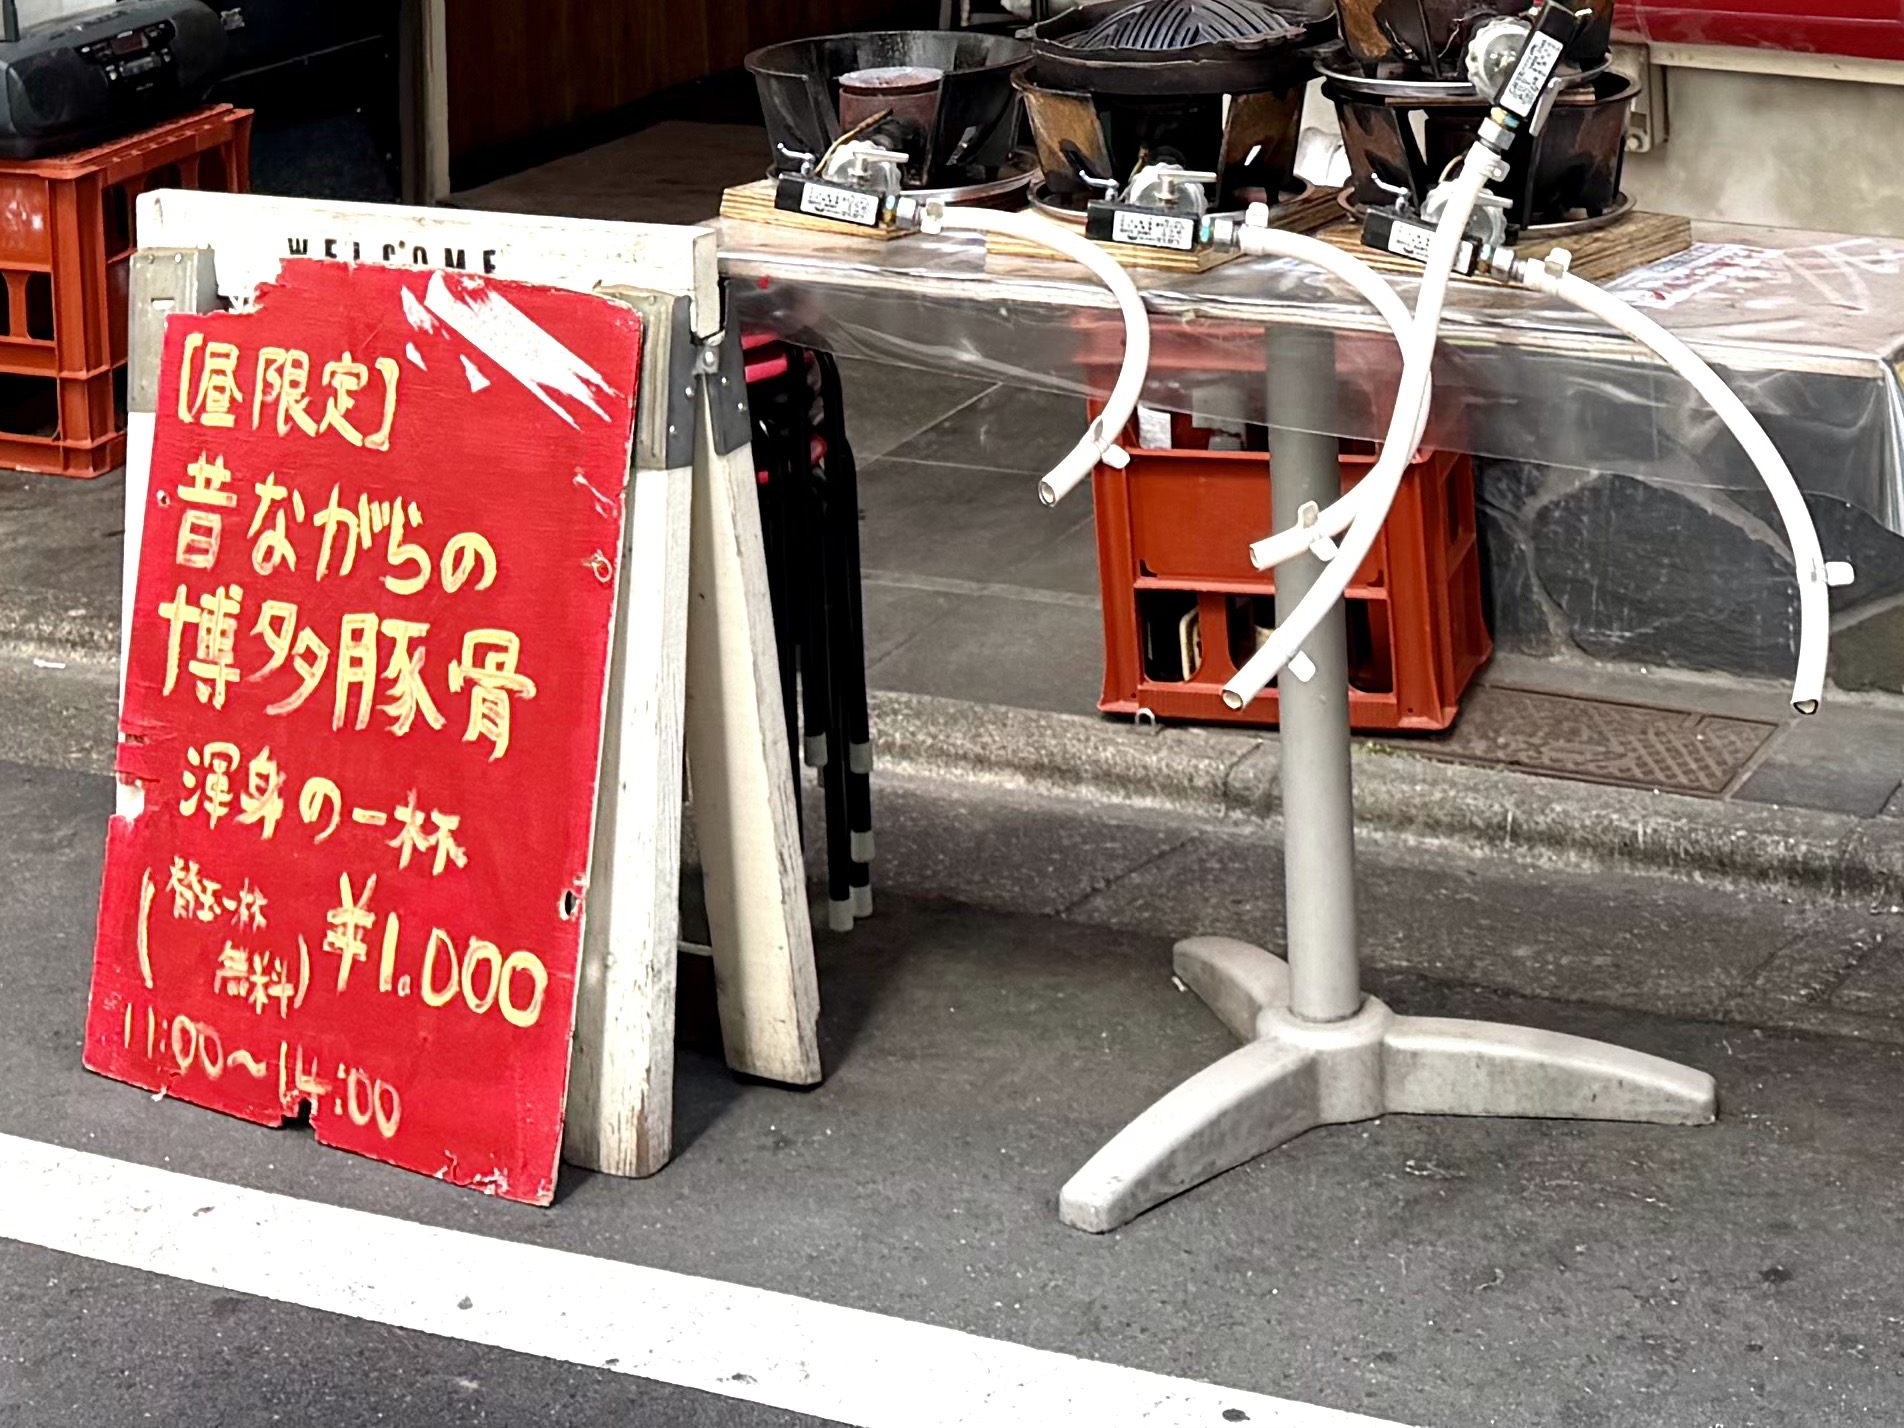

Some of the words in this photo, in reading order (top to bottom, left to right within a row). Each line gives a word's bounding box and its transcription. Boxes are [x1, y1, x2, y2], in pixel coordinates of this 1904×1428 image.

[176, 452, 497, 596] 昔ながらの
[158, 584, 537, 762] 博多豚骨
[178, 742, 469, 877] 渾身の一杯
